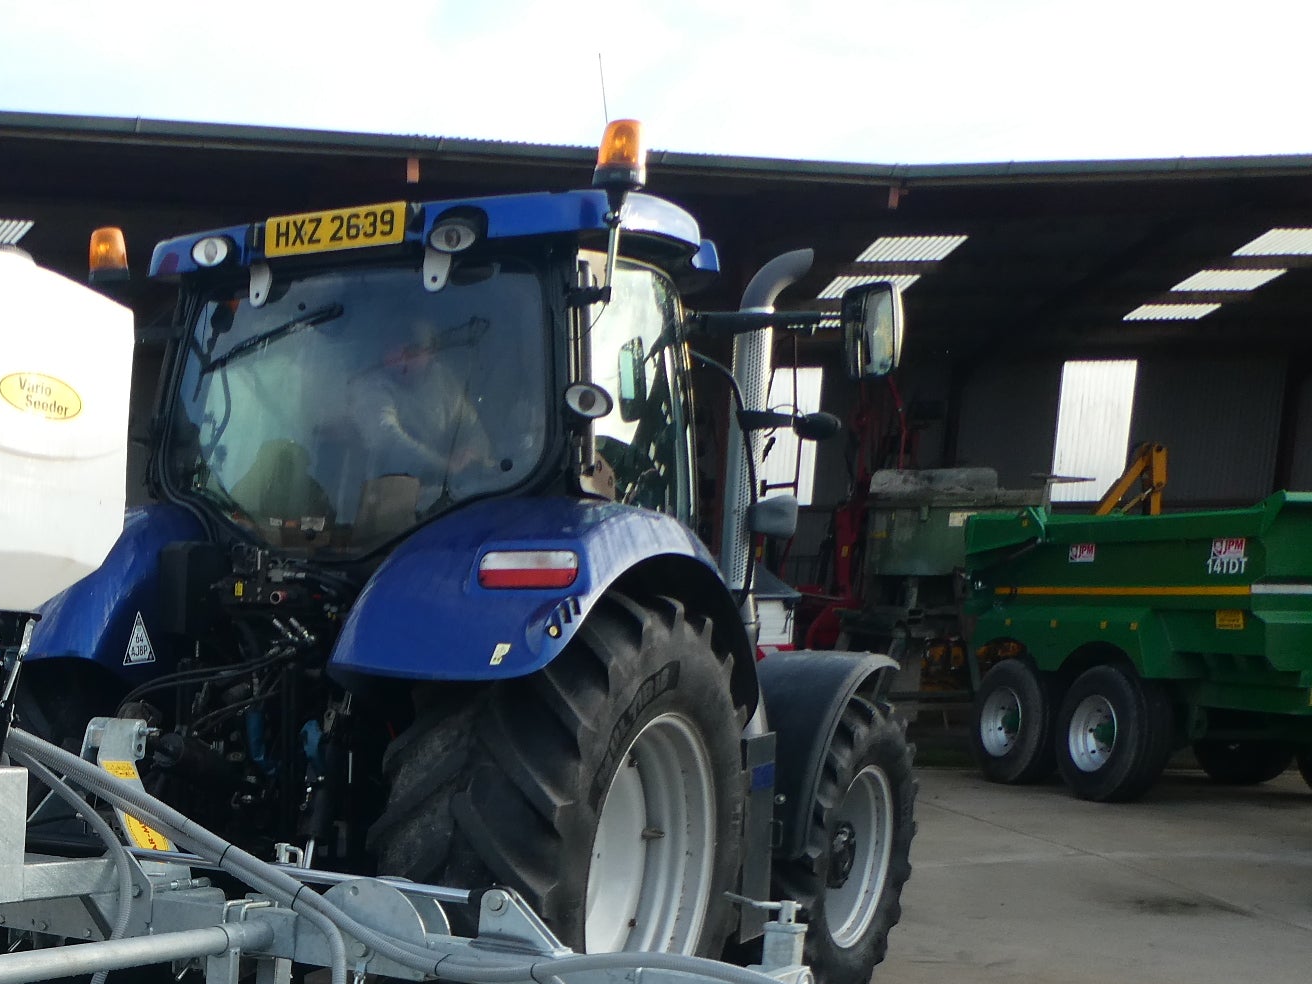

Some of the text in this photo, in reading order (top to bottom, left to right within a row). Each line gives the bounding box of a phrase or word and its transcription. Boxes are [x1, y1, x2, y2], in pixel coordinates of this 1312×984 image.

[275, 209, 395, 248] HXZ 2639
[18, 375, 52, 397] Vario
[25, 393, 69, 417] Seeder
[1222, 538, 1244, 556] JPM
[1206, 557, 1248, 574] 14TDT
